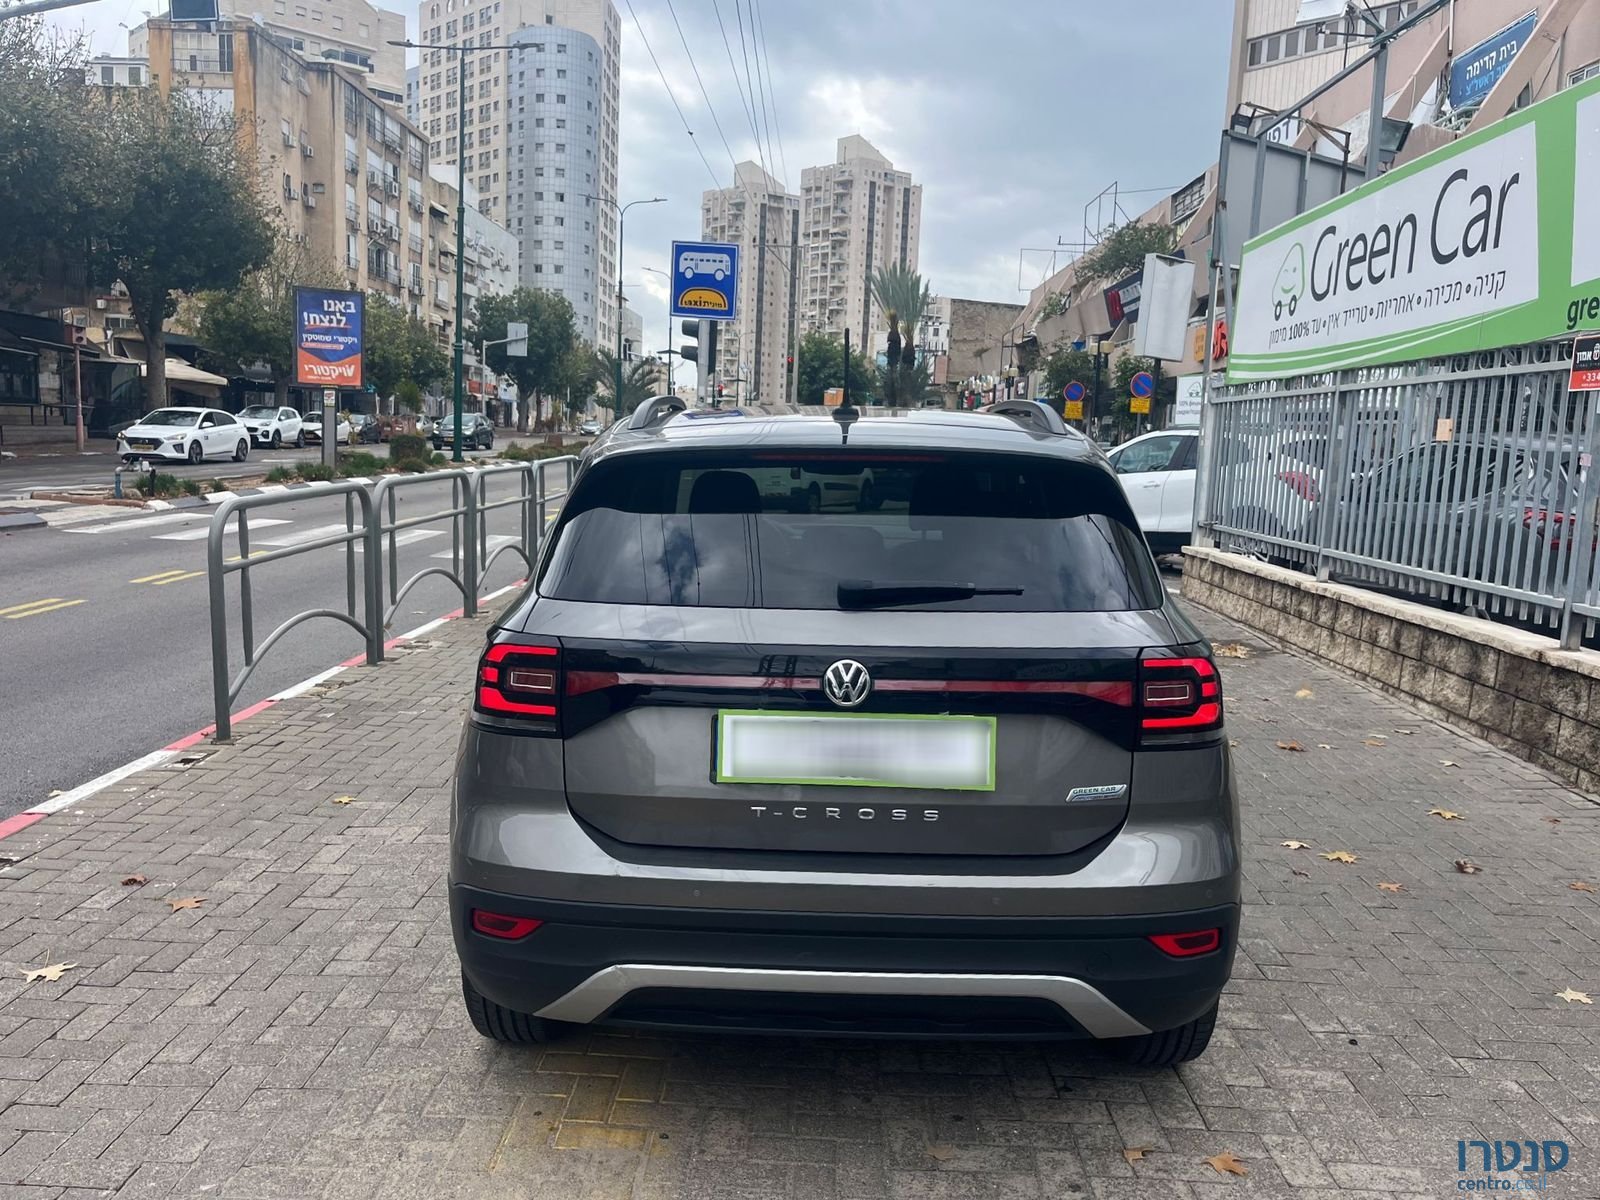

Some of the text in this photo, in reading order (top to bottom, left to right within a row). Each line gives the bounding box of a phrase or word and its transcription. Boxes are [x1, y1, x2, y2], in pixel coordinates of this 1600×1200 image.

[1466, 40, 1518, 80] בית קדימה
[1310, 168, 1520, 302] Green Car
[323, 299, 356, 313] באנו
[684, 296, 722, 309] taxi מונית
[1269, 270, 1506, 350] קניה מכירה אחריות טרייד אין עד 100% מימון
[303, 311, 347, 327] לנצח!
[1072, 787, 1099, 795] GREEN
[750, 806, 940, 822] T-CROSS
